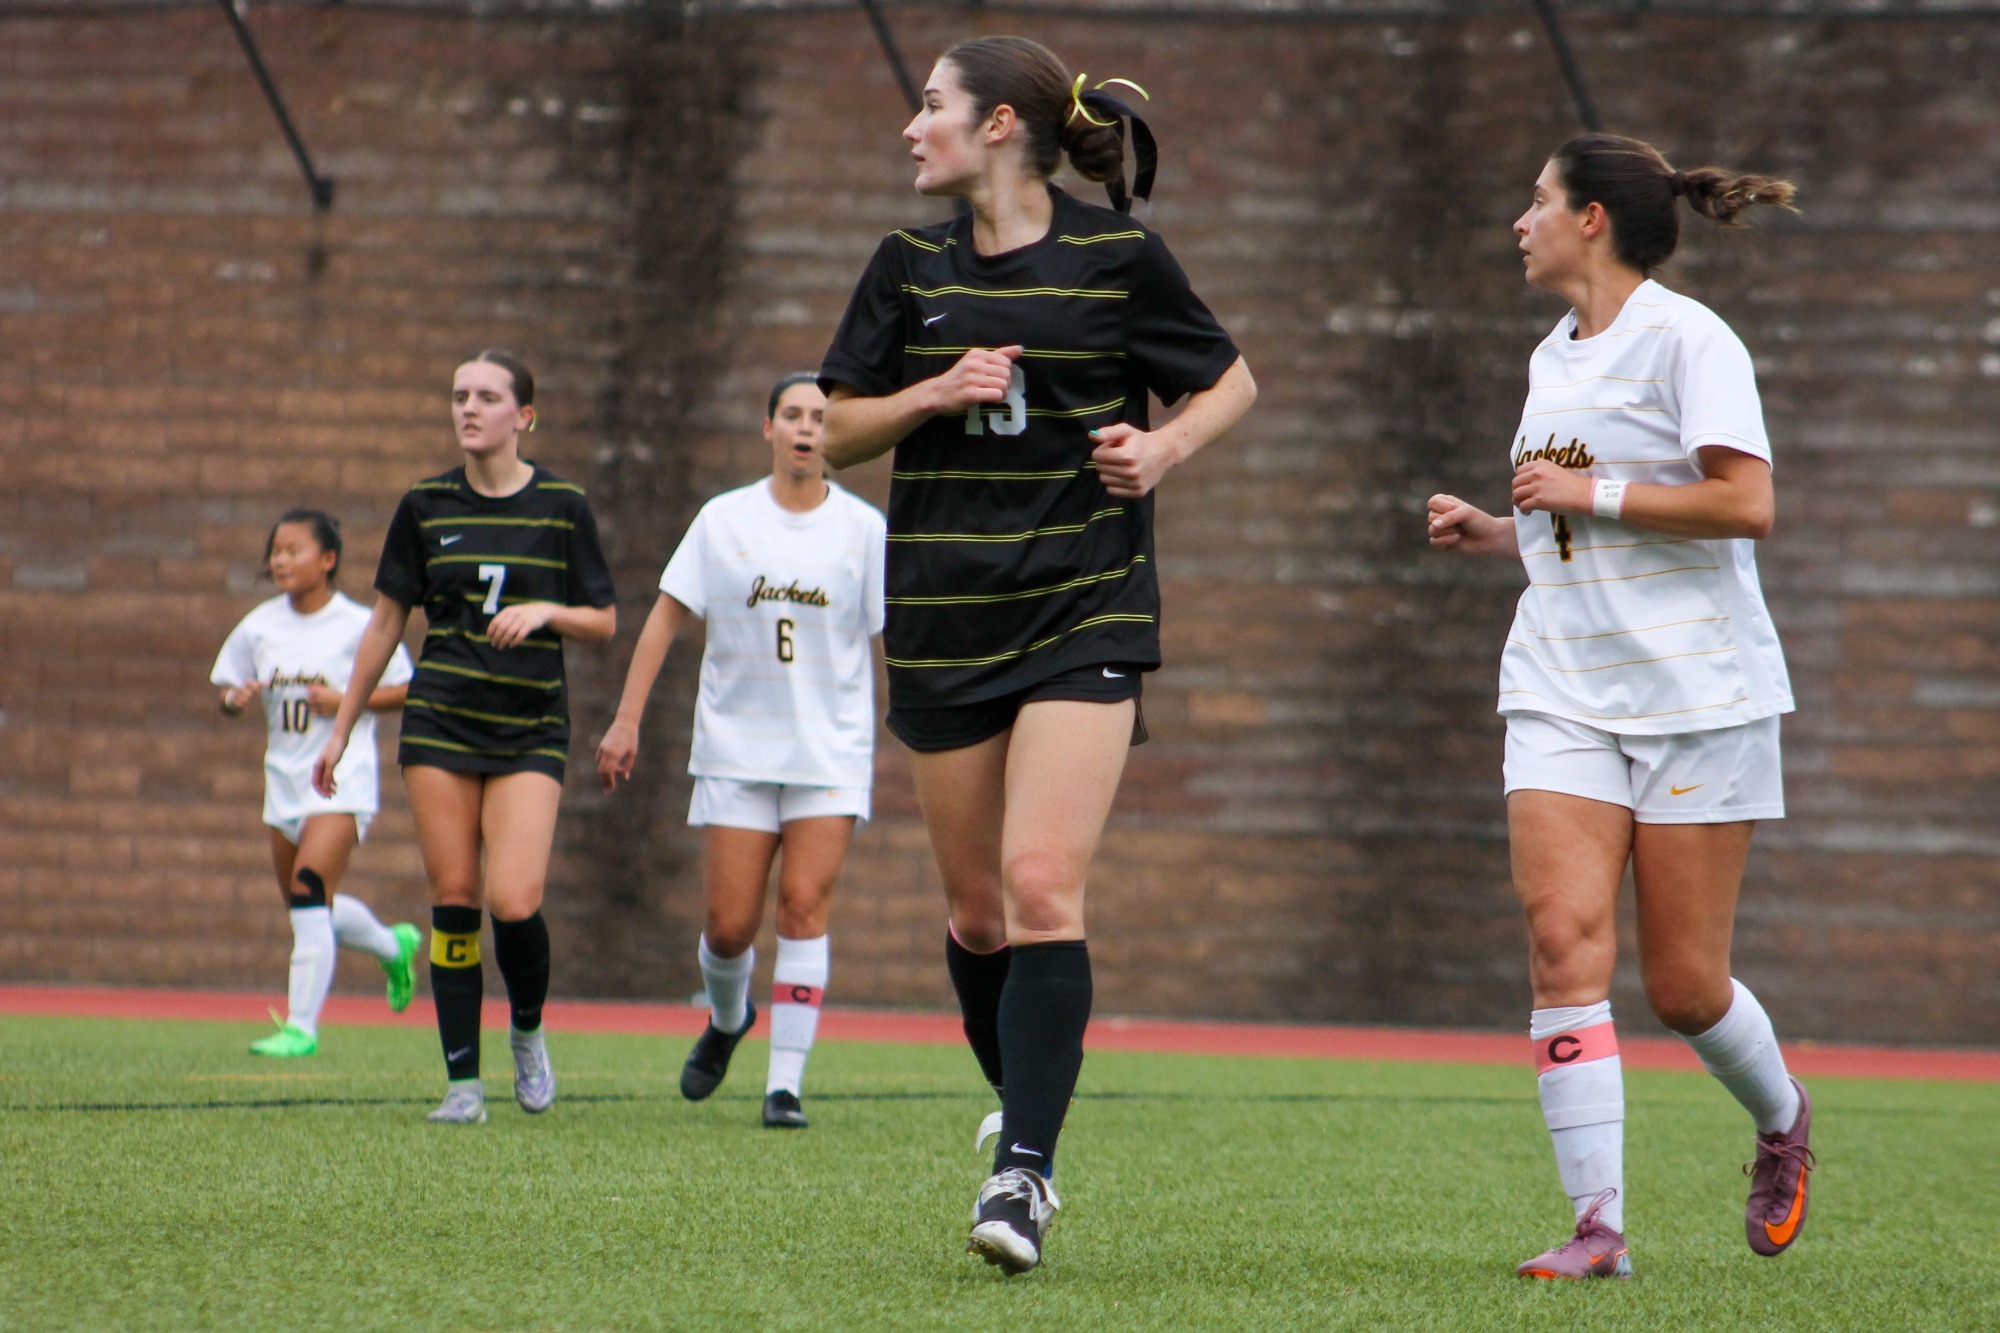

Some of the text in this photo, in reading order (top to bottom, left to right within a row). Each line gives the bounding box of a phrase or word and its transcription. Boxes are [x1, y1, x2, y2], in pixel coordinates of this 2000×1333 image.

[1550, 513, 1572, 562] 4
[478, 564, 505, 615] 7
[746, 575, 829, 608] Jackets
[776, 618, 794, 662] 6
[282, 698, 310, 733] 10
[445, 938, 467, 962] C
[791, 984, 811, 1004] C
[1547, 1035, 1582, 1064] C
